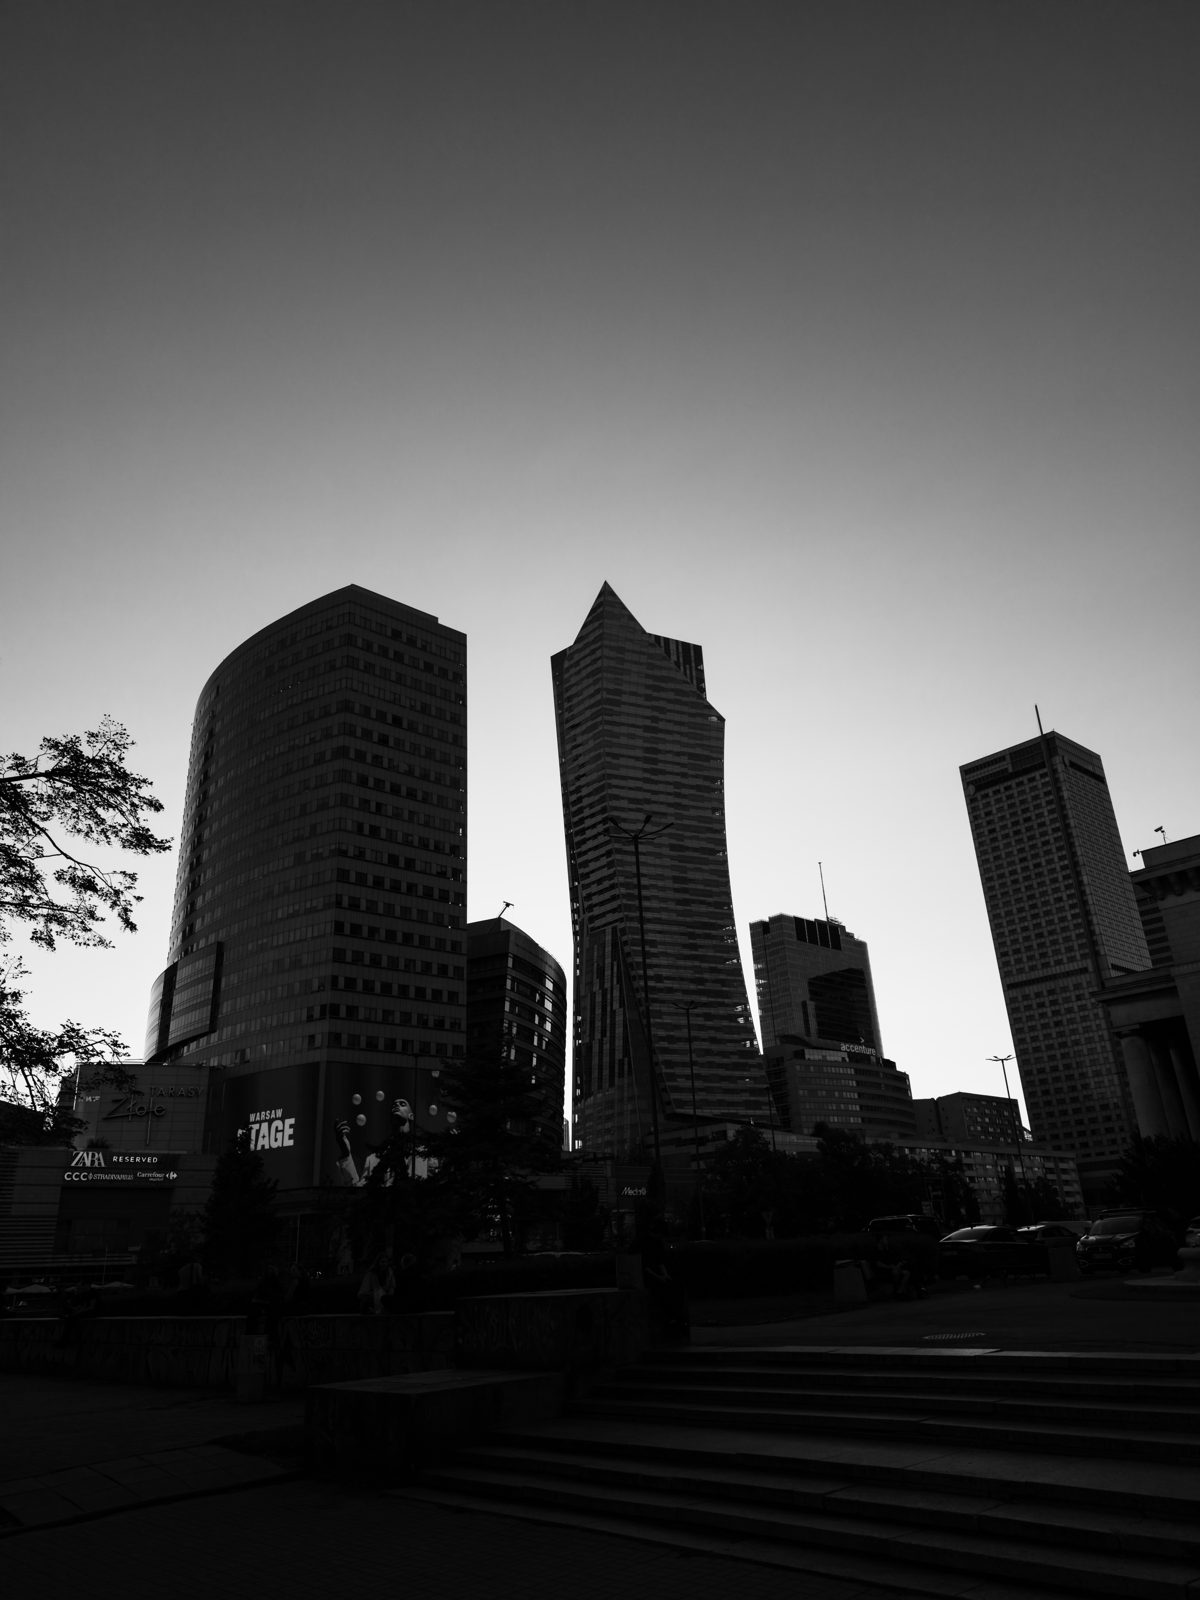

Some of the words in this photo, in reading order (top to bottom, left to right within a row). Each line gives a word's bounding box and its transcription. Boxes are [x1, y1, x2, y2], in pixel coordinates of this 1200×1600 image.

[840, 1042, 876, 1055] accenture
[150, 1087, 203, 1097] TARASY
[249, 1108, 283, 1122] WARSAW
[70, 1151, 105, 1167] ZARA
[64, 1172, 88, 1181] CCC
